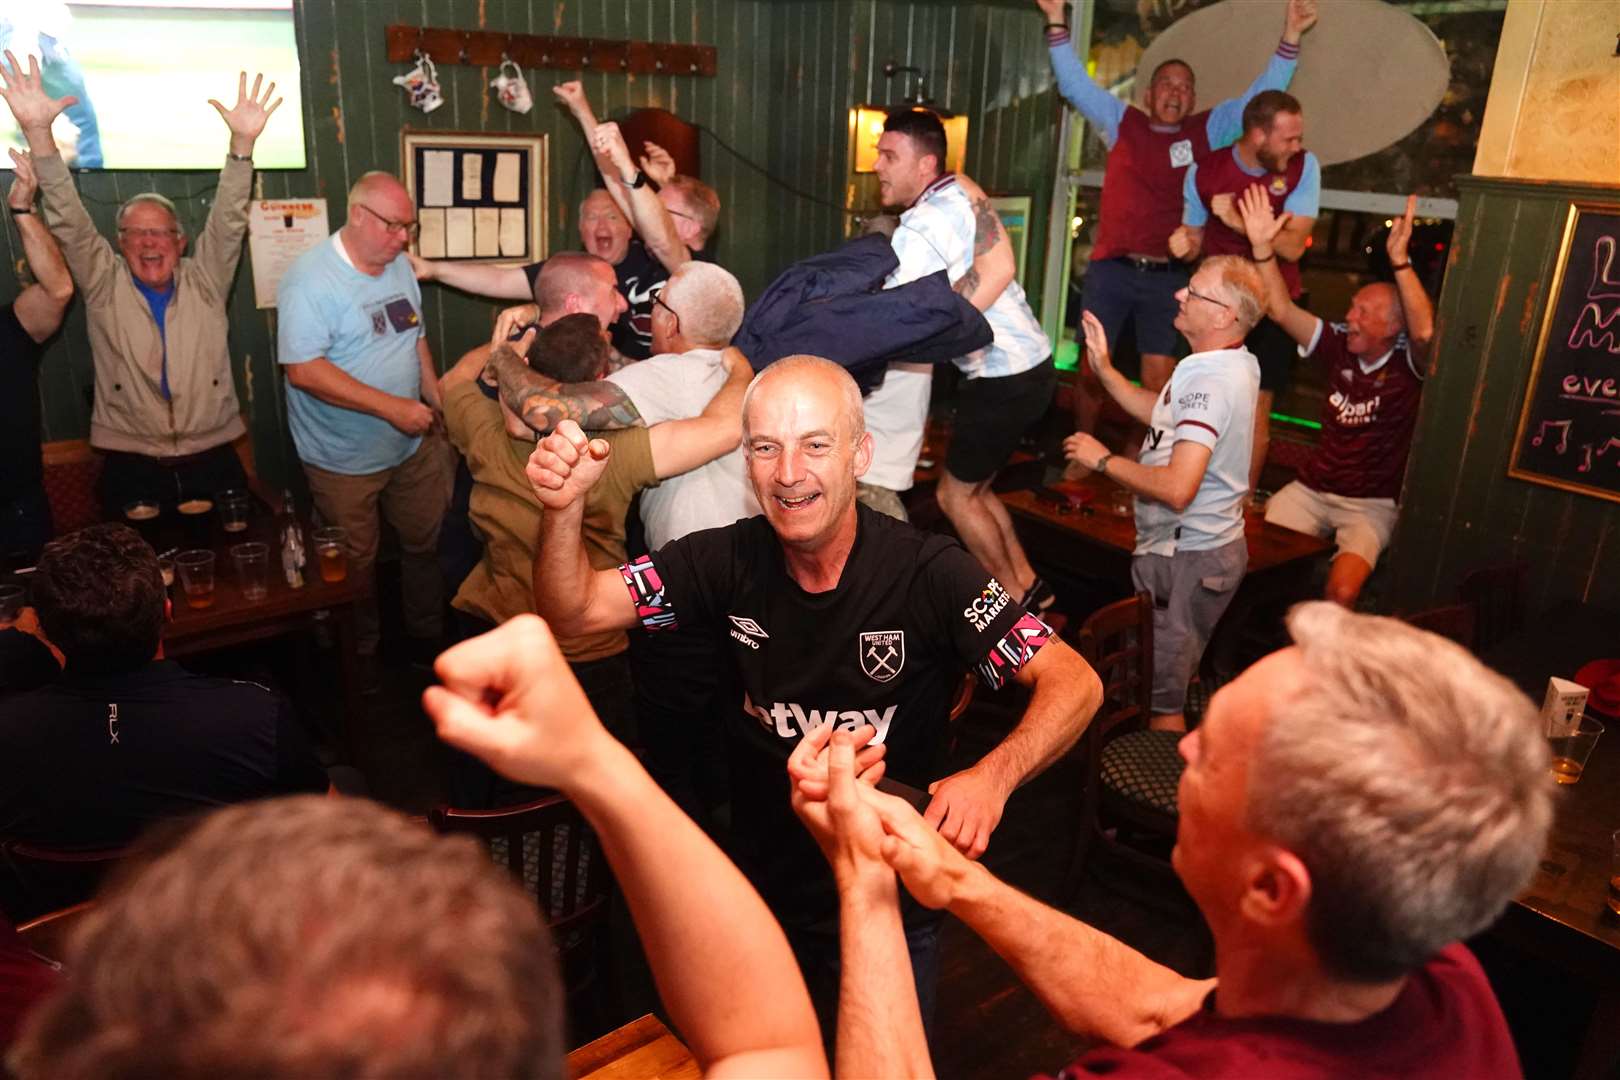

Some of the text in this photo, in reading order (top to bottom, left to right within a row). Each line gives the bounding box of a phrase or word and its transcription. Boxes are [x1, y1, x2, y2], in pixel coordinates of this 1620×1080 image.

[963, 578, 1003, 623] SCOPE
[974, 591, 1010, 632] MARKETS
[730, 629, 760, 649] umbro
[864, 633, 900, 642] WEST HAM
[108, 703, 120, 745] RLX
